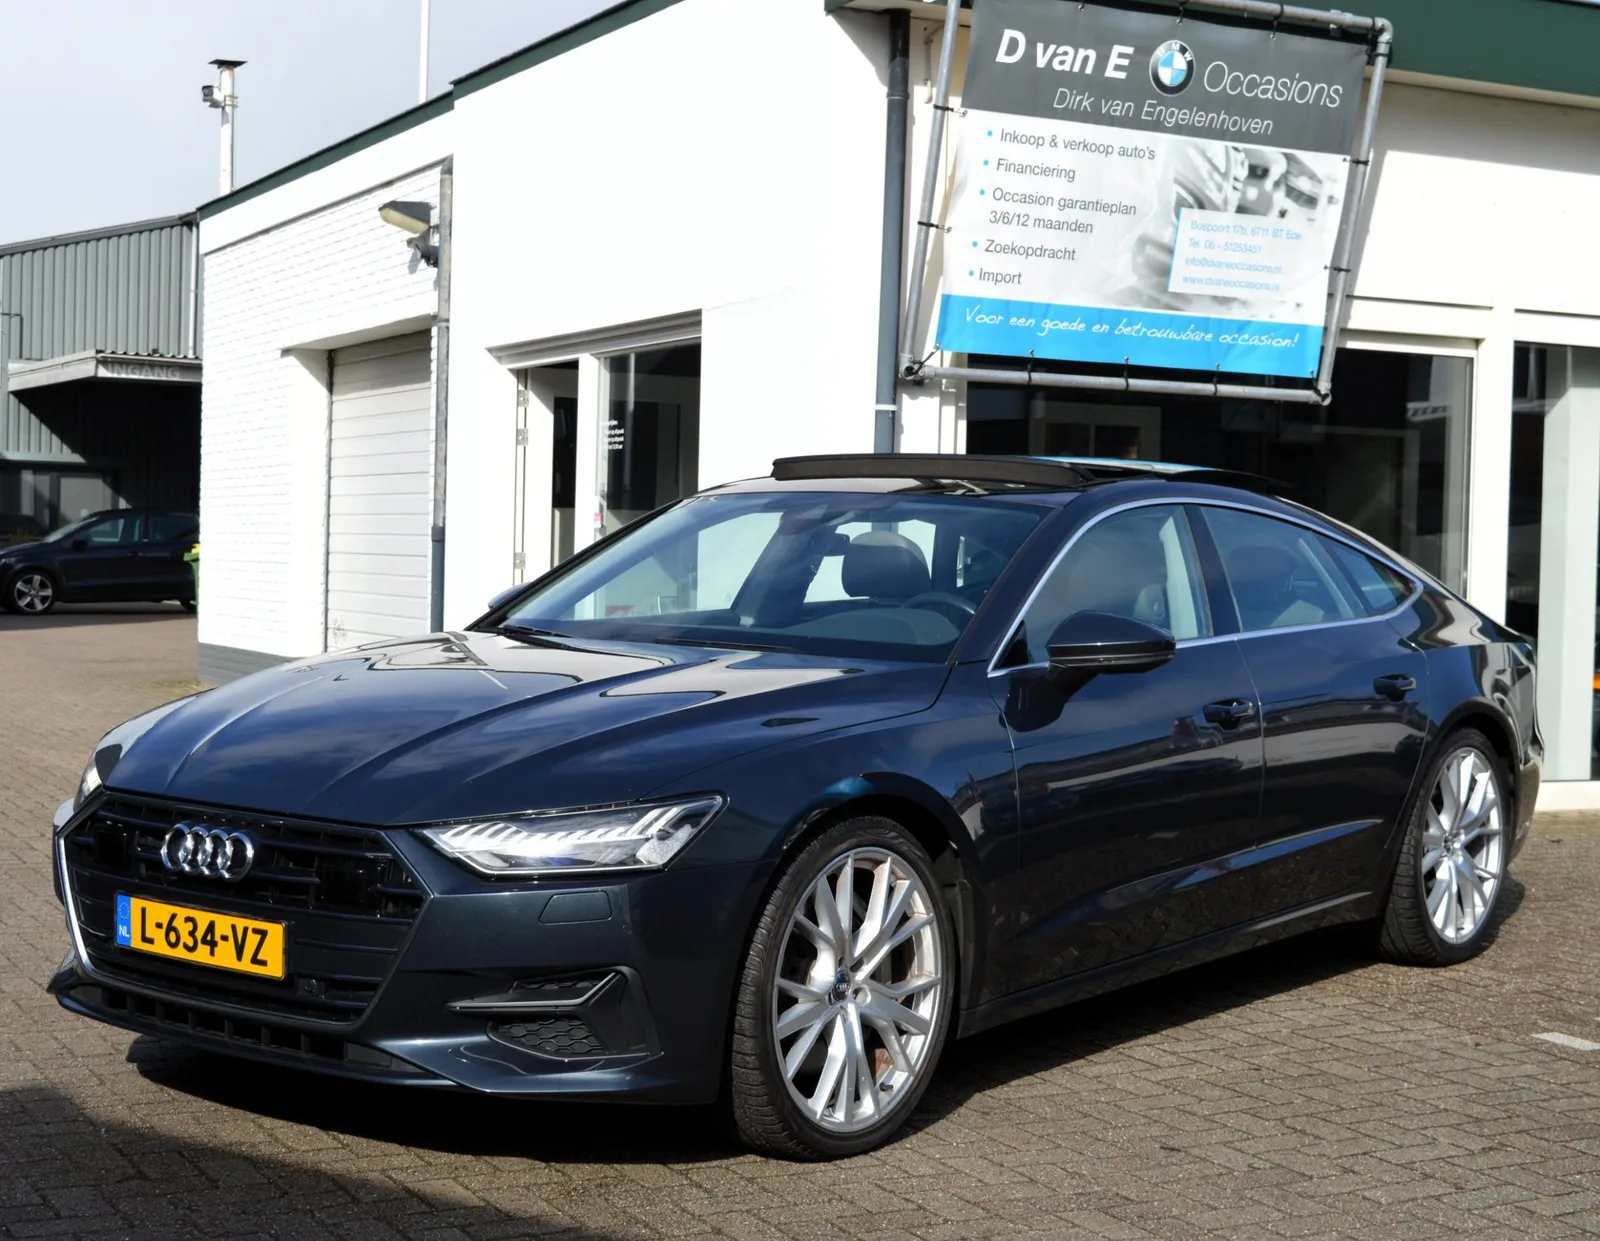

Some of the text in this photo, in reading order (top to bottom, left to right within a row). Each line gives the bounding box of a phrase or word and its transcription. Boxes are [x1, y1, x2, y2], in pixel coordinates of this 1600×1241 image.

[995, 28, 1134, 79] D van E
[1204, 61, 1343, 108] Occasions
[1053, 87, 1274, 136] Dirk van Engelenhoven
[1000, 129, 1156, 160] Inkoop & verkoop auto's
[996, 158, 1076, 183] Financiering
[992, 187, 1137, 216] Occasion garantieplan
[989, 210, 1094, 233] 3/6/12 maanden
[1272, 228, 1284, 238] BT
[985, 239, 1076, 260] Zoekopdracht
[979, 268, 1022, 285] Import
[964, 305, 1299, 348] Voor een goede en betrouwbare occasion!
[108, 363, 180, 379] INGANG
[118, 925, 130, 937] NL
[141, 907, 268, 967] L-634-VZ
